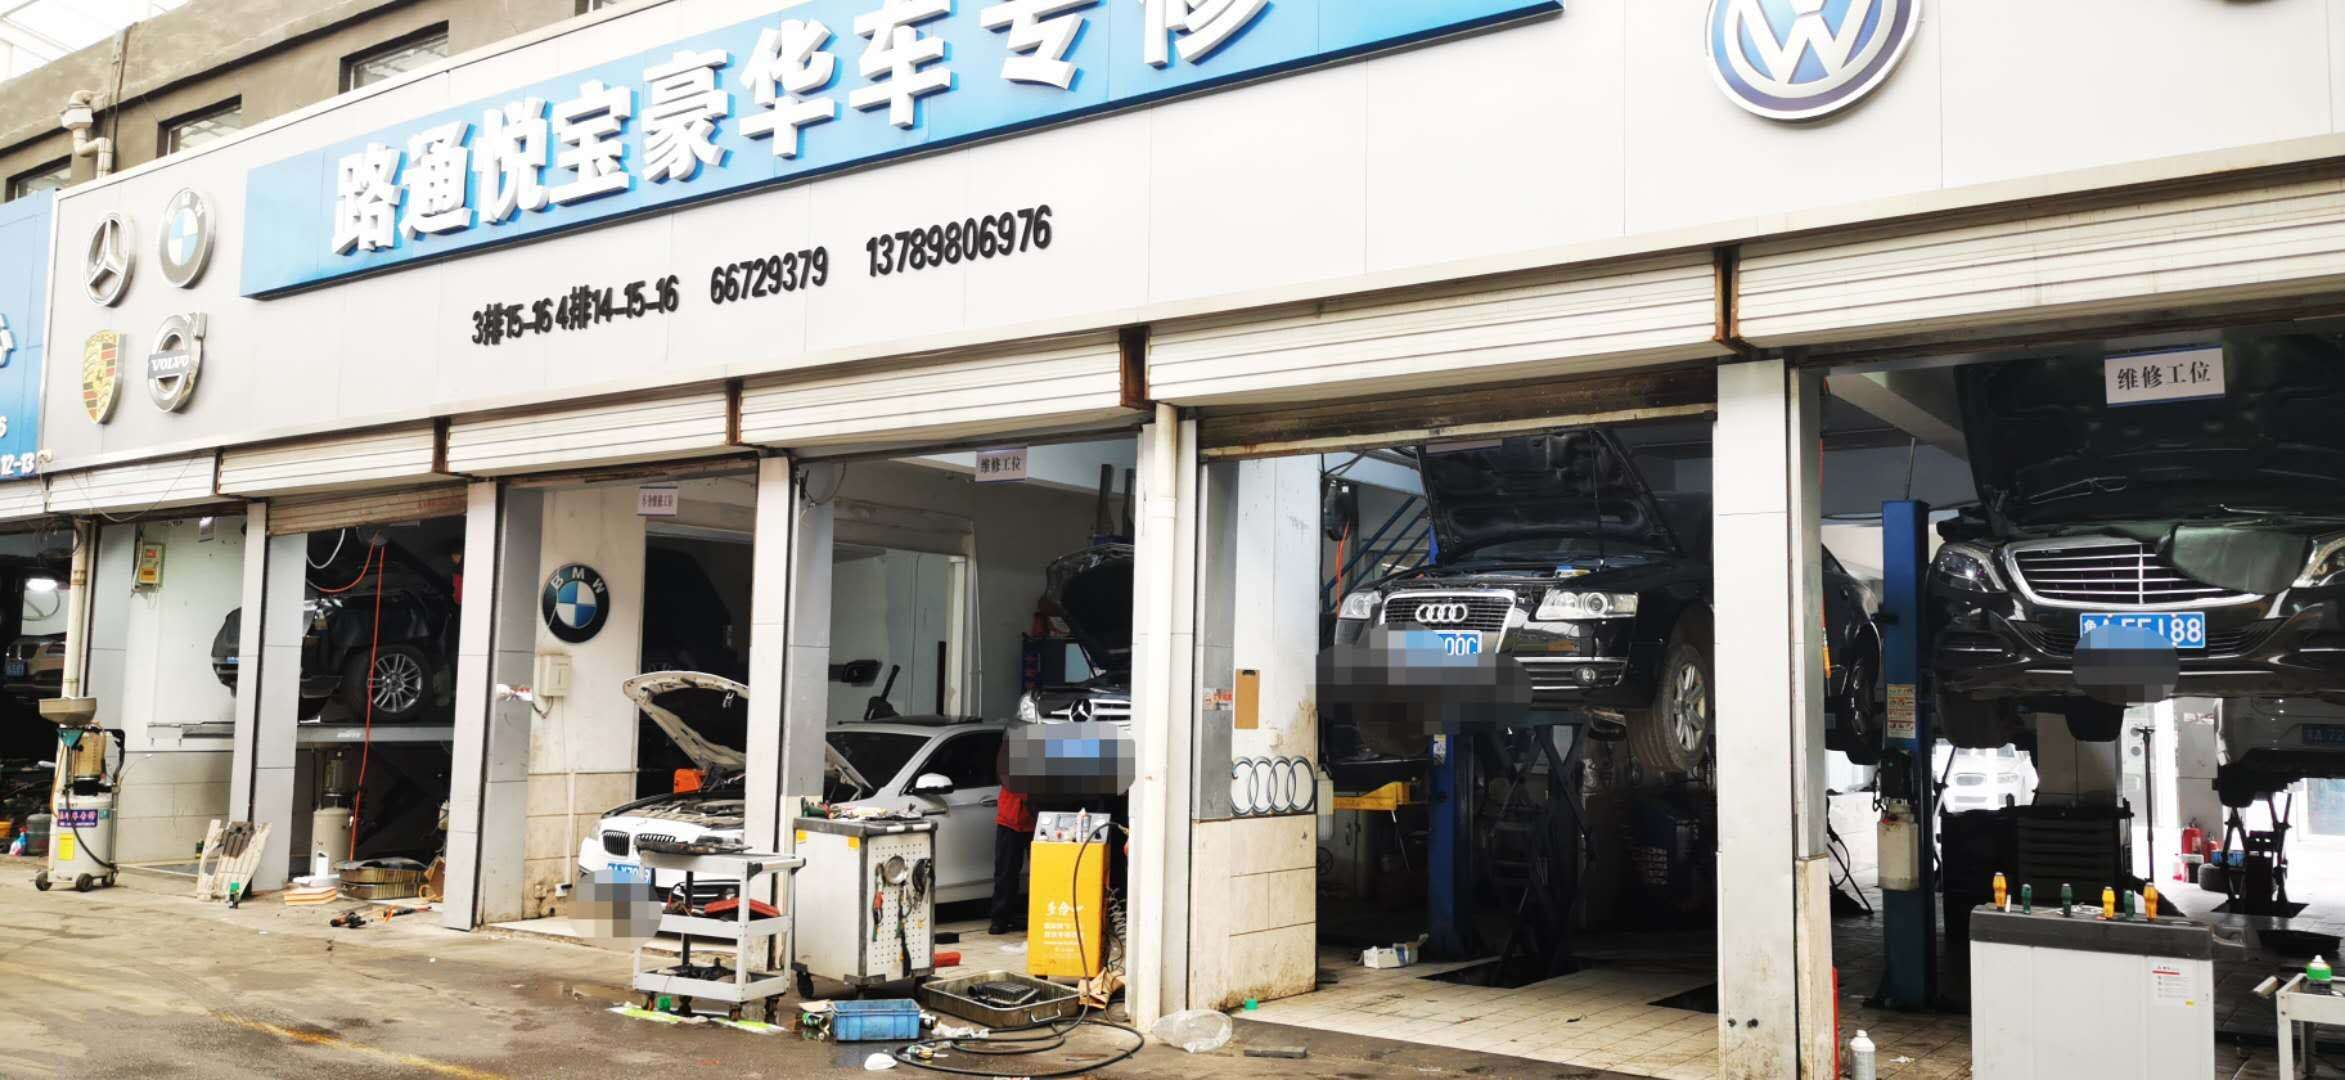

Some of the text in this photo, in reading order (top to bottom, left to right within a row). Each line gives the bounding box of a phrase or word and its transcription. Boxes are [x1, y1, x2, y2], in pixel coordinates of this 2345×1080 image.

[711, 246, 829, 305] 66729379
[866, 204, 1053, 277] 13789806976
[150, 355, 190, 371] VOLVO
[2117, 360, 2211, 390] 维修工位
[550, 566, 606, 594] BMW
